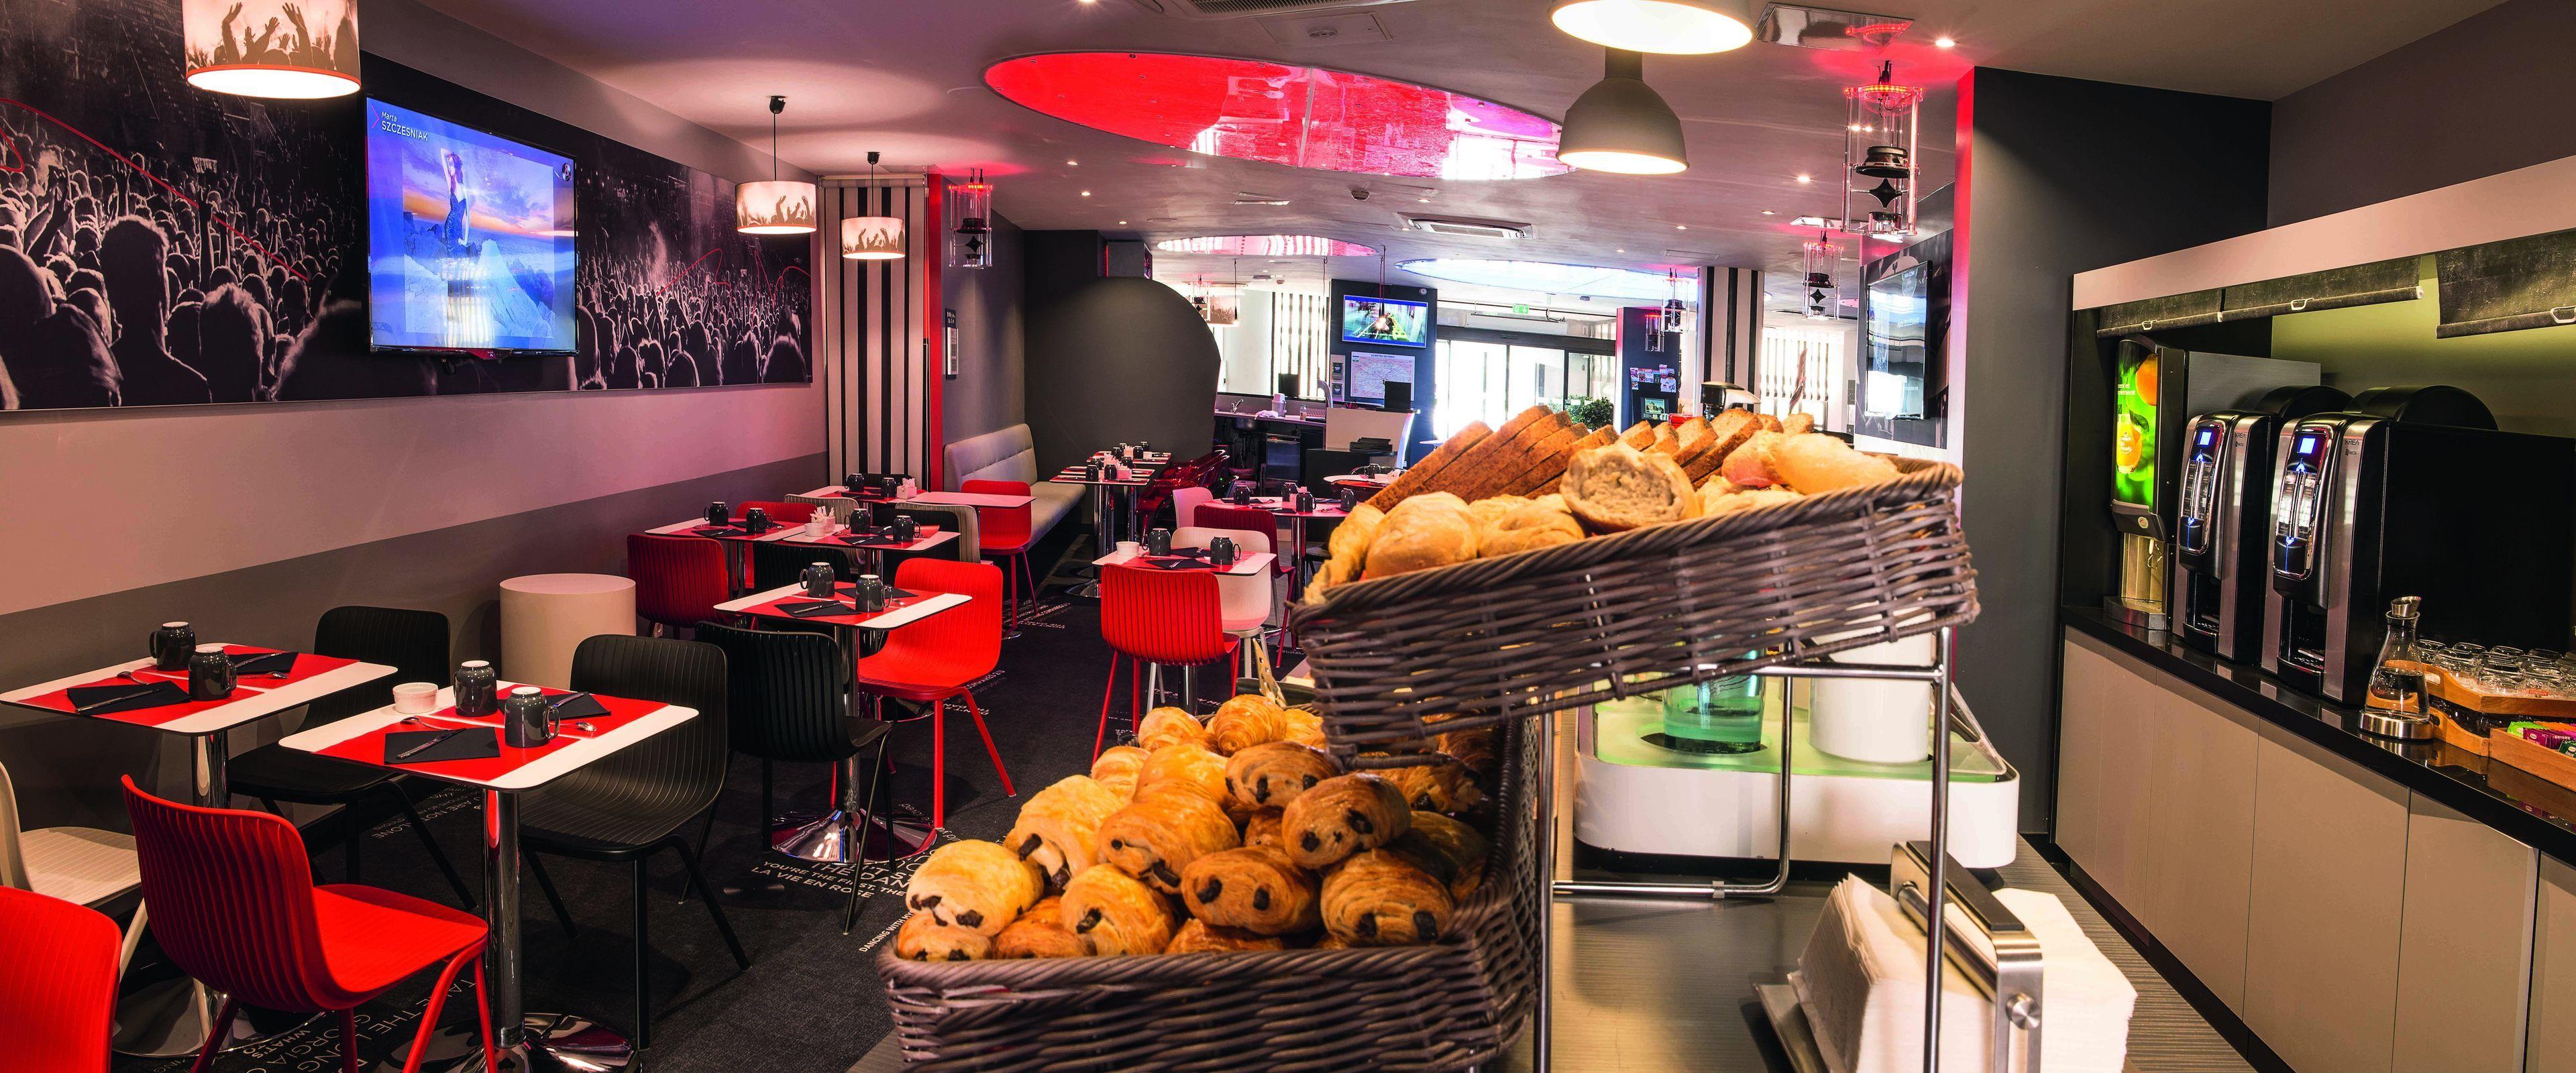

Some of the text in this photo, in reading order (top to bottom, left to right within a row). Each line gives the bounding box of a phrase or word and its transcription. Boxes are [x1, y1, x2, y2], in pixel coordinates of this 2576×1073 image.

[381, 111, 397, 122] Marta
[382, 121, 428, 141] SZCZESNIAK
[751, 866, 771, 875] LA
[777, 872, 804, 883] VIE
[804, 879, 828, 888] EN
[763, 861, 810, 875] YOU'RE
[811, 872, 837, 881] THE
[880, 887, 907, 897] THE
[811, 862, 855, 876] THE
[860, 872, 910, 889] DAN
[859, 909, 914, 952] DANCING WITH MY
[368, 1010, 422, 1035] THE
[252, 1028, 311, 1059] WHAT'S
[266, 1014, 371, 1065] GORGIA
[297, 1033, 372, 1073] LNG
